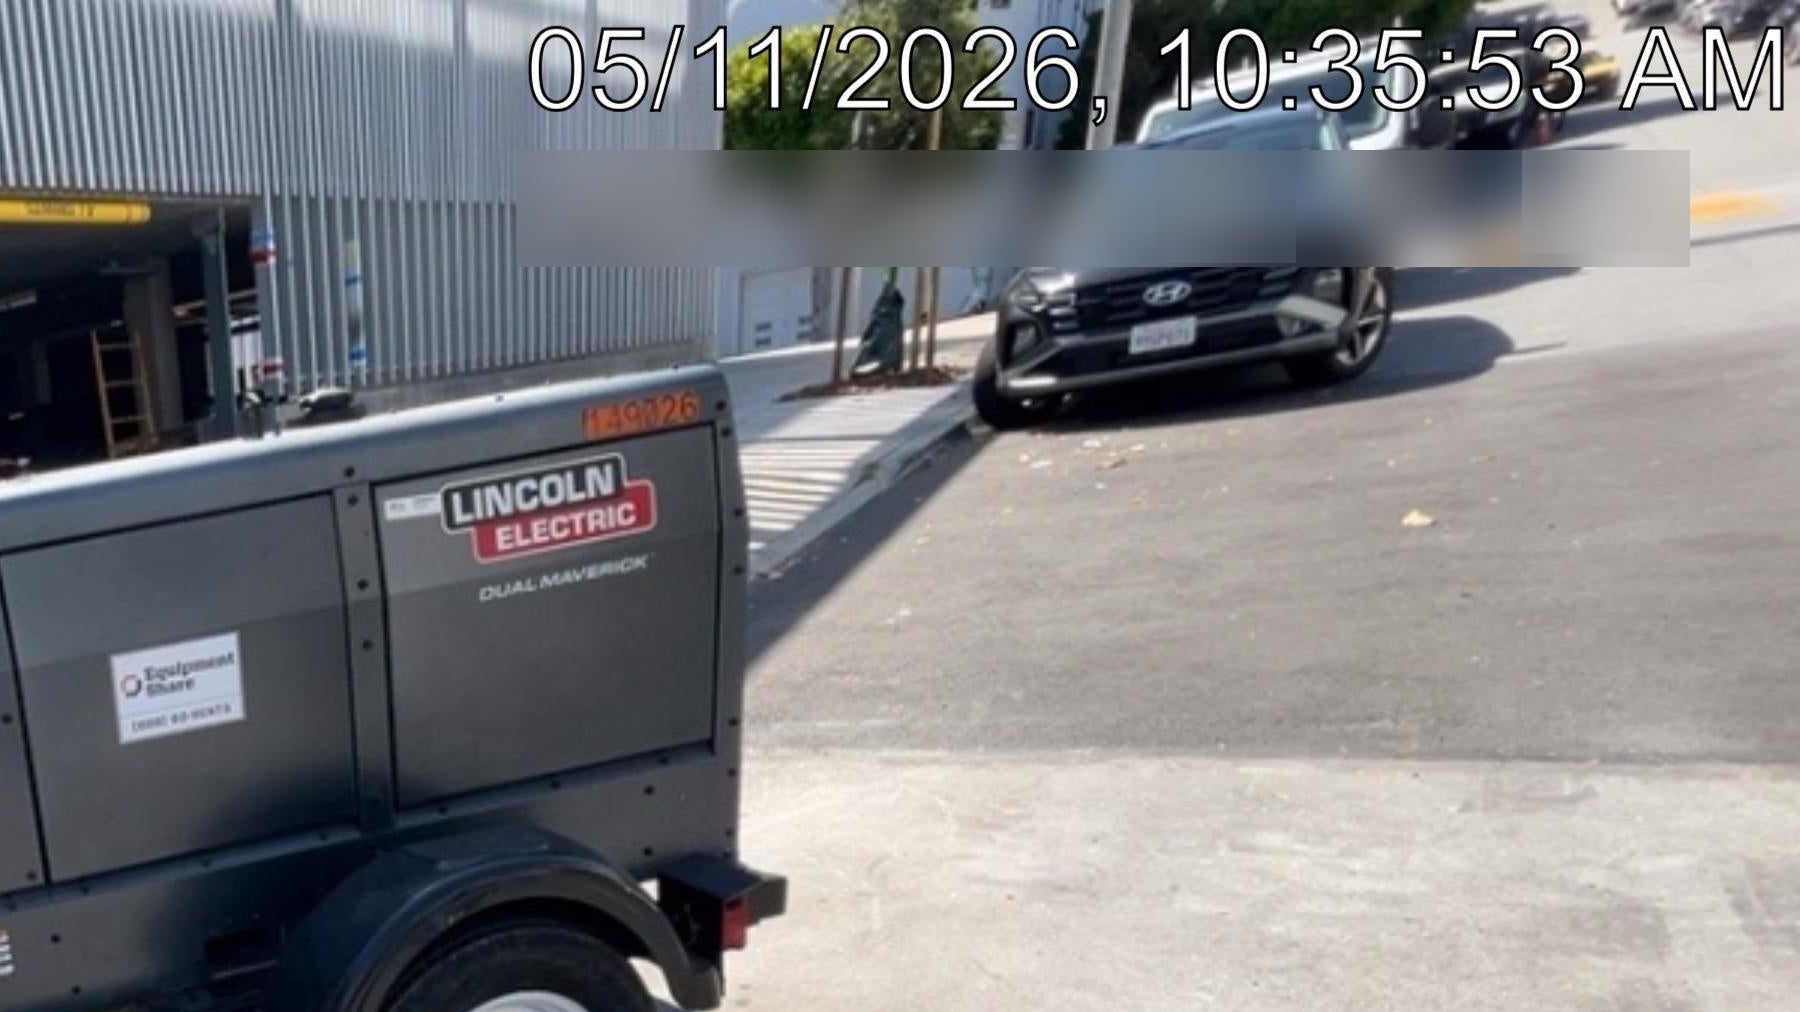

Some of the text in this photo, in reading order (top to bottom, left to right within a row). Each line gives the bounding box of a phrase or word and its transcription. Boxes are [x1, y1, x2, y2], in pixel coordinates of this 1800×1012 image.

[452, 463, 615, 524] LINCOLN
[495, 502, 637, 551] ELECTRIC
[479, 554, 649, 602] DUAL MAVERICK
[144, 652, 235, 681] Equipment
[146, 678, 195, 697] Share
